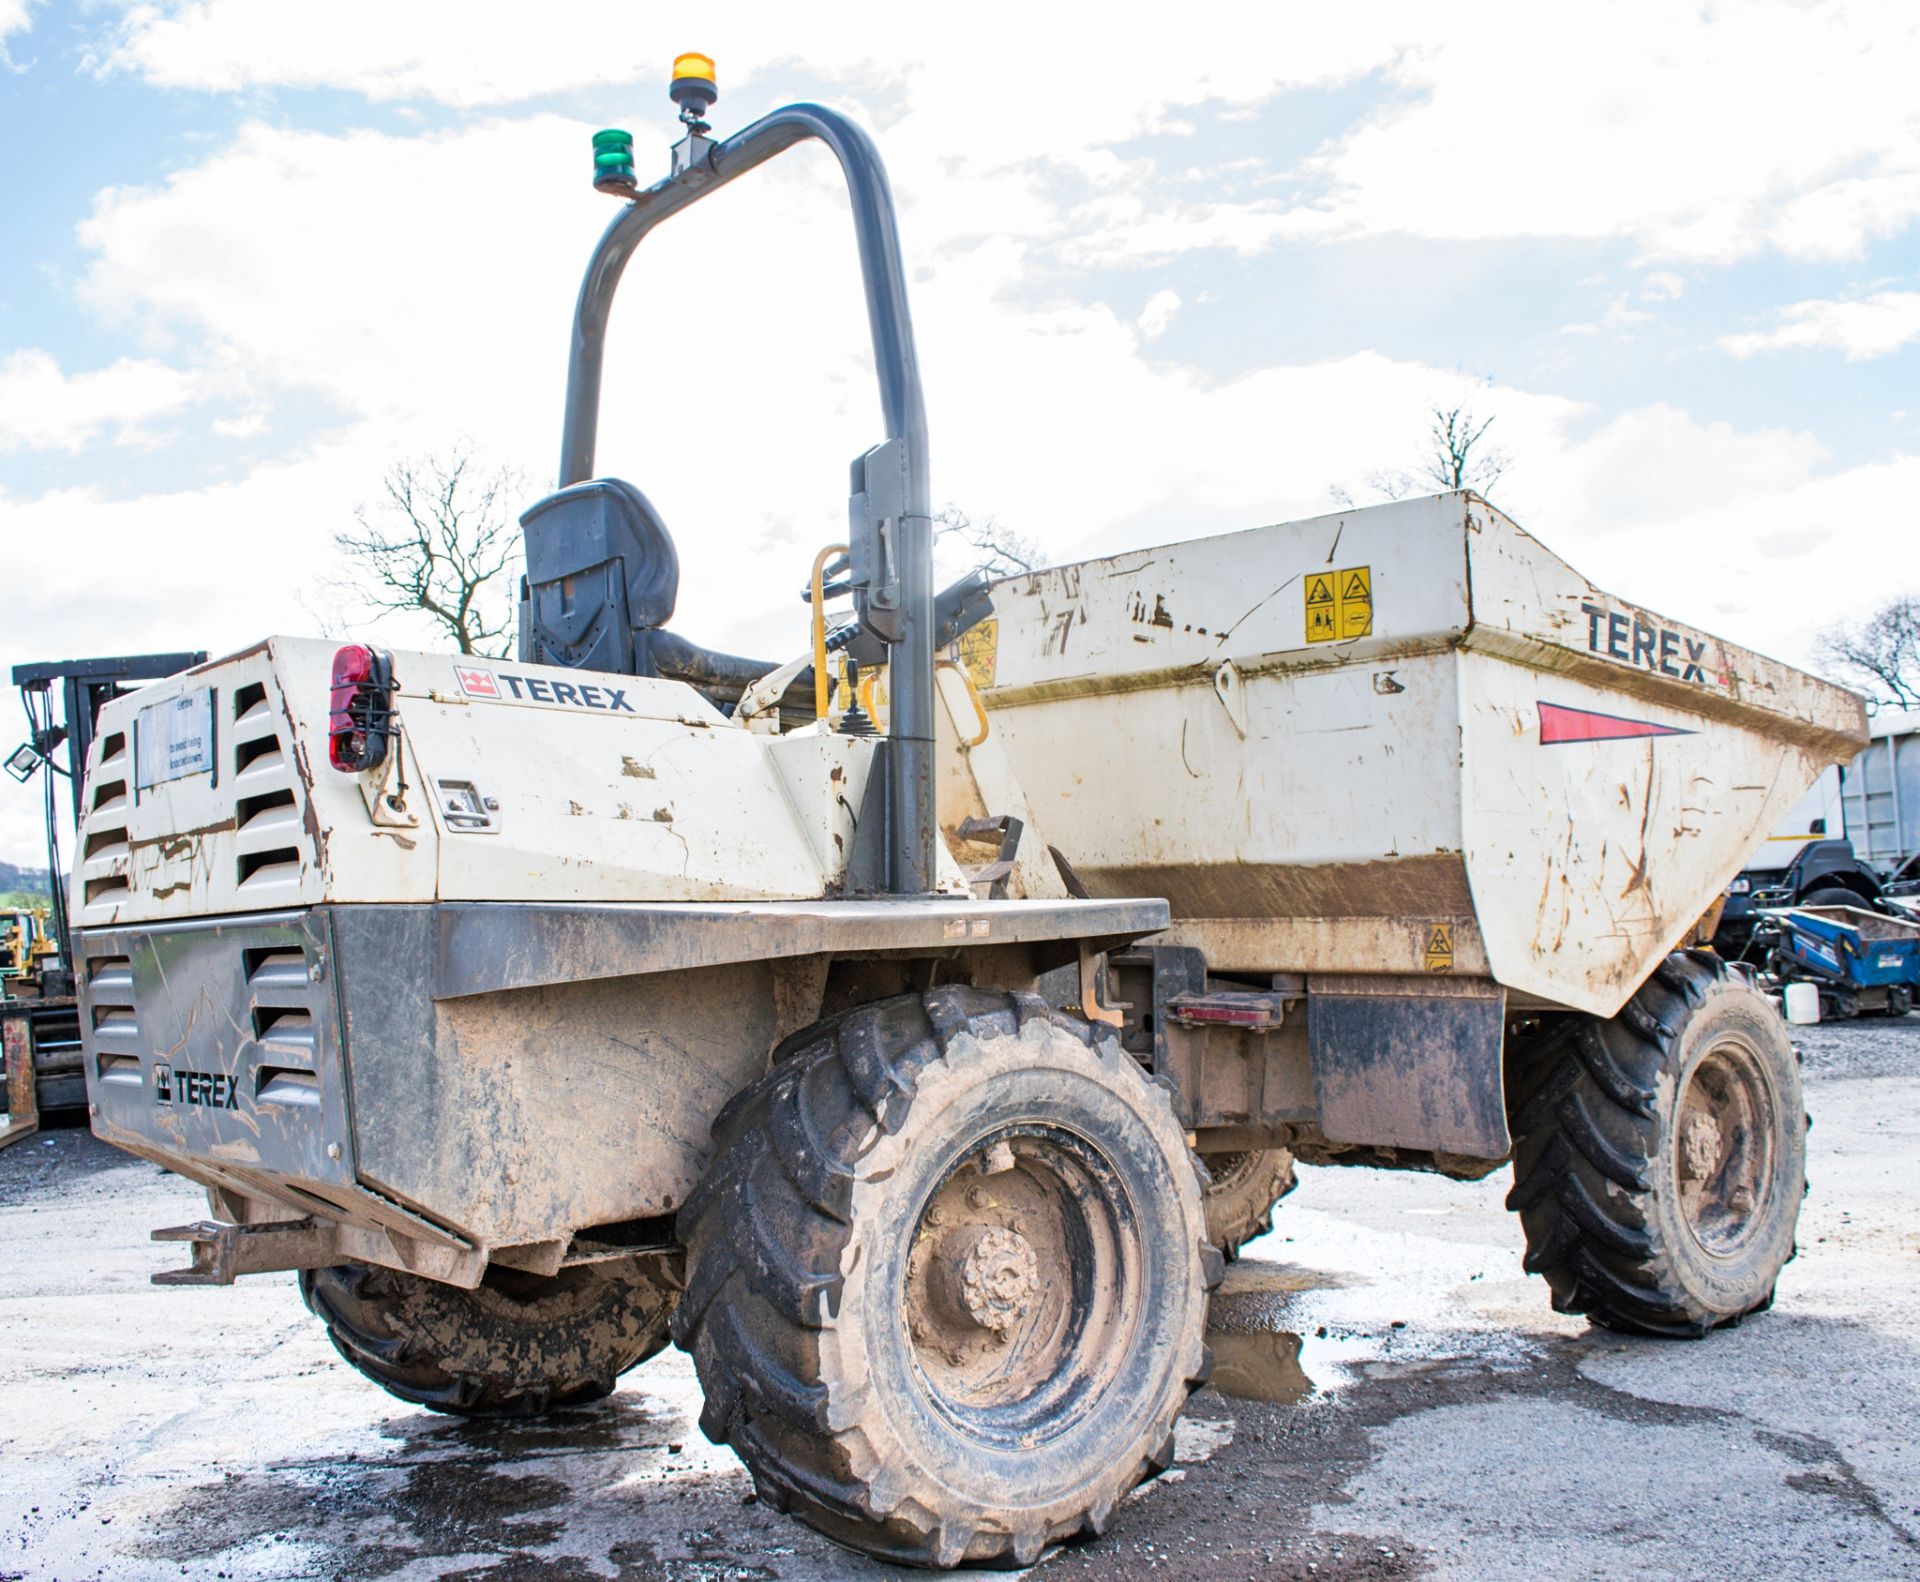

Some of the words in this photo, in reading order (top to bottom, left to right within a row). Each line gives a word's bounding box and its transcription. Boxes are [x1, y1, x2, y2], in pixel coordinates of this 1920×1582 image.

[1581, 602, 1706, 683] TEREX
[498, 674, 637, 712] TEREX
[174, 1070, 239, 1111] TEREX
